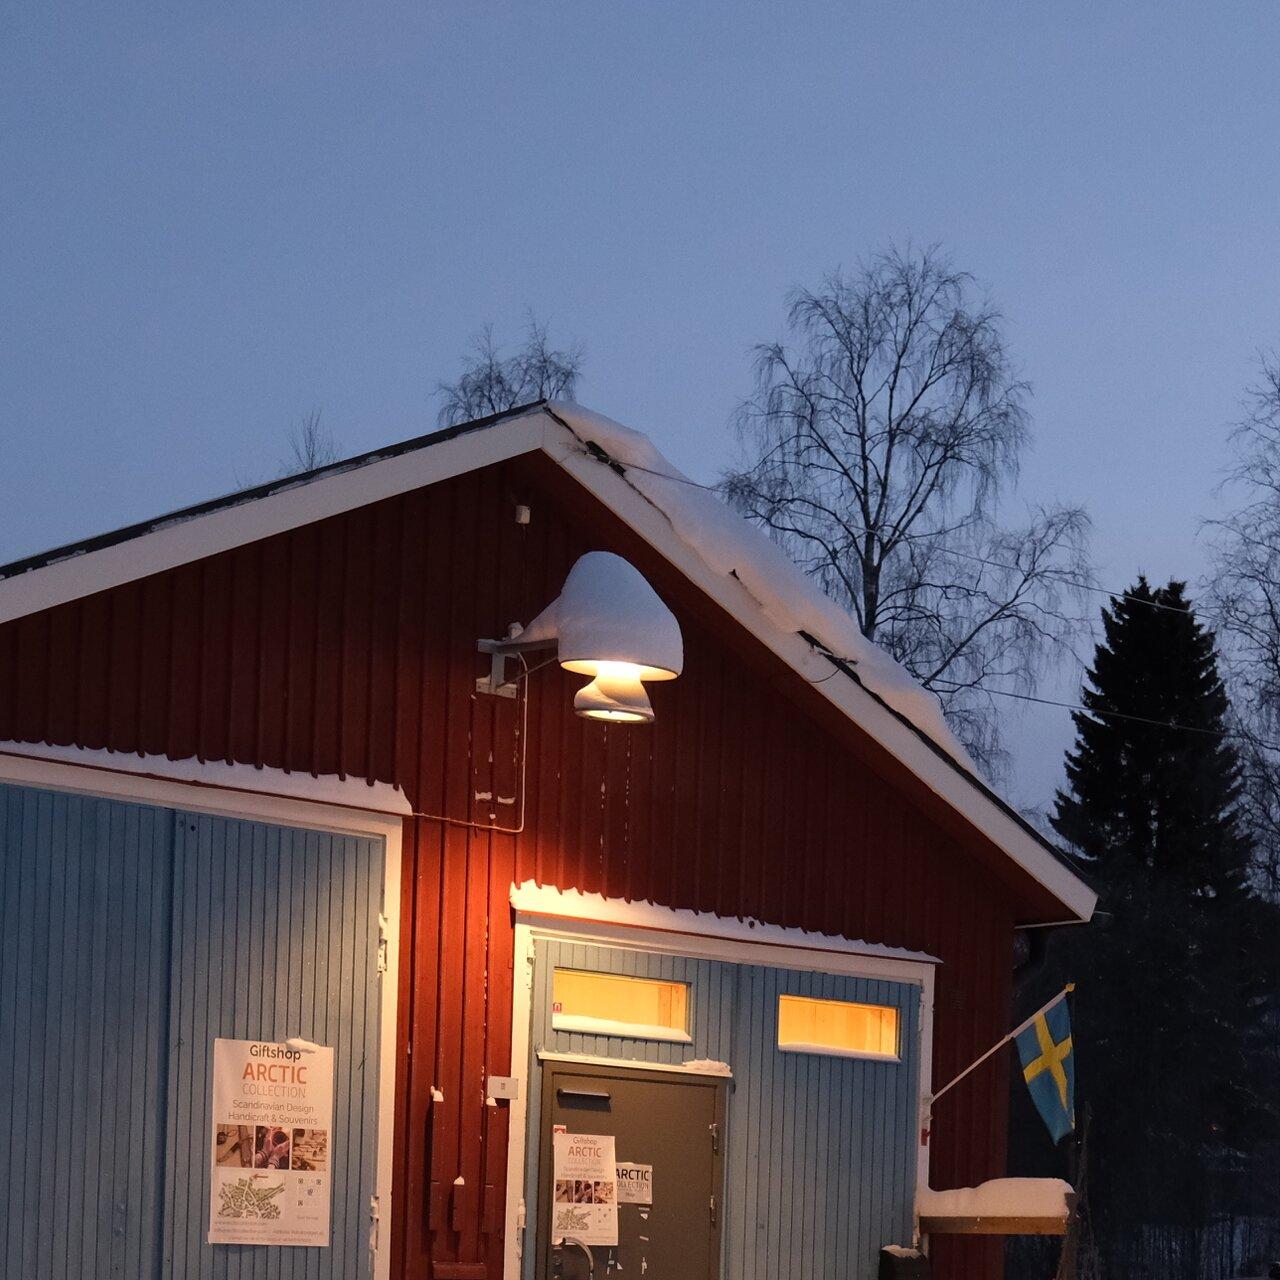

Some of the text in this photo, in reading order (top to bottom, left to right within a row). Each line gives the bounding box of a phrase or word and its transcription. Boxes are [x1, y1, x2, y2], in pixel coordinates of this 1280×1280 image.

[249, 1044, 301, 1063] Giftshop
[242, 1062, 307, 1084] ARCTIC
[242, 1083, 306, 1098] COLLECTION
[232, 1099, 314, 1114] Scandinavian Design
[228, 1112, 318, 1125] Handicraft & Souvenirs
[568, 1146, 602, 1158] ARCTIC
[616, 1180, 649, 1190] OLLECTION
